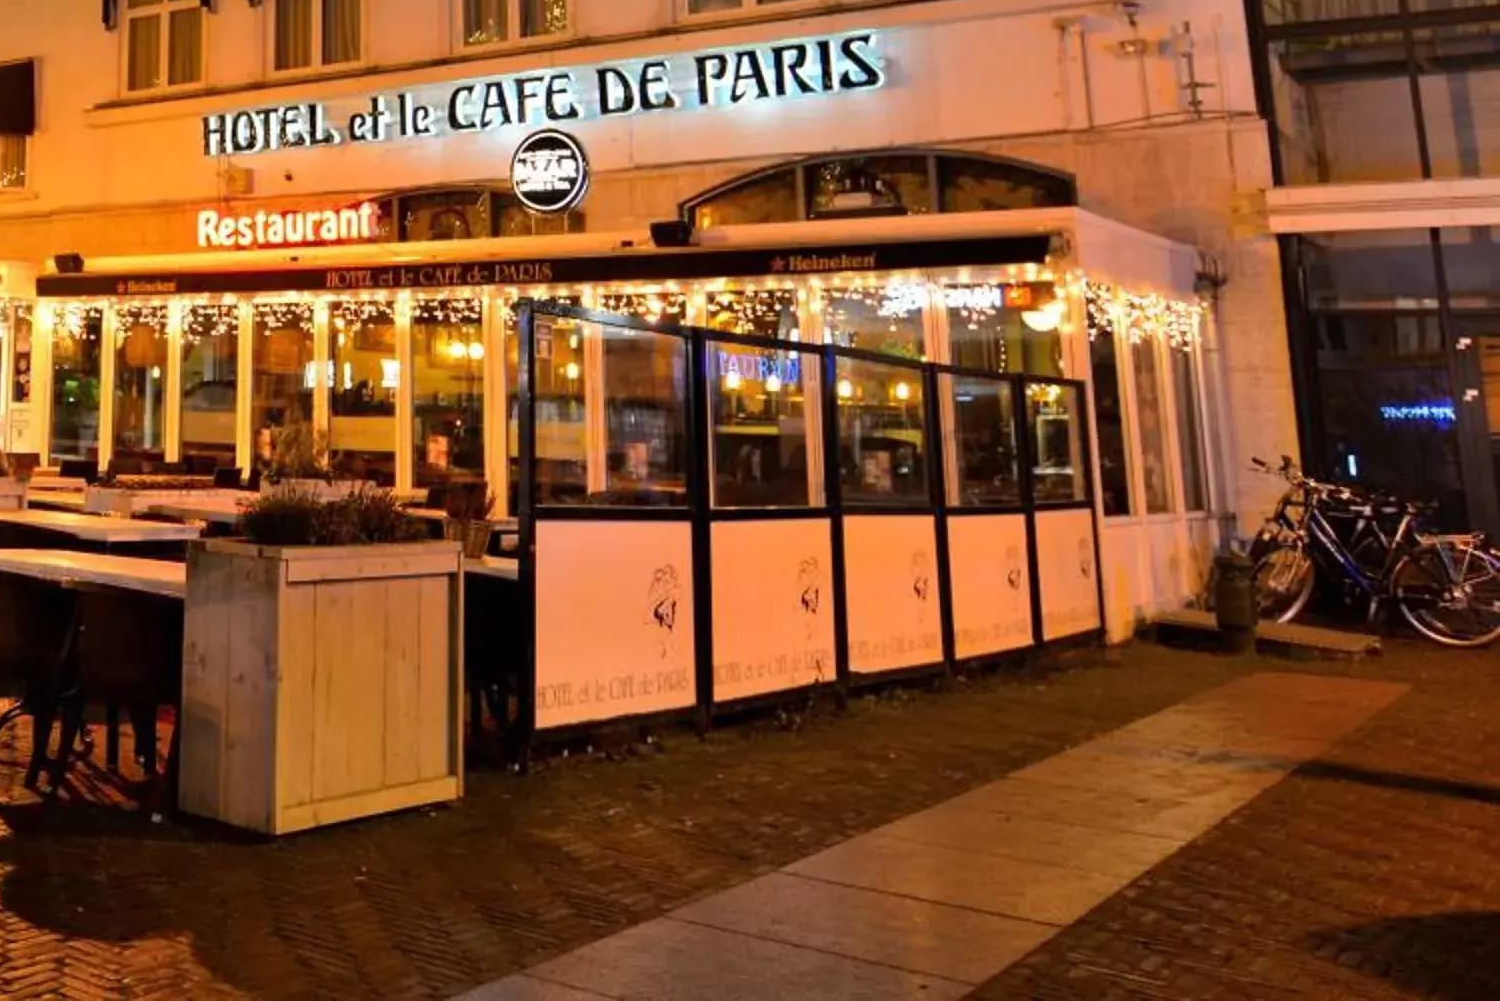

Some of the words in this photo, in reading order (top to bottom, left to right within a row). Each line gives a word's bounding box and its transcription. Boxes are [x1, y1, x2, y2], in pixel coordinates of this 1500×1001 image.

[202, 103, 342, 156] HOTEL
[349, 95, 388, 142] et
[397, 92, 436, 135] le
[448, 73, 583, 130] CAFE
[596, 60, 680, 116] DE
[693, 33, 885, 107] PARIS
[197, 201, 380, 247] Restaurant
[325, 270, 372, 288] HOTEL
[379, 269, 394, 286] et
[400, 267, 414, 284] le
[467, 265, 489, 283] de
[494, 262, 553, 282] PARIS
[788, 252, 877, 271] Heineken
